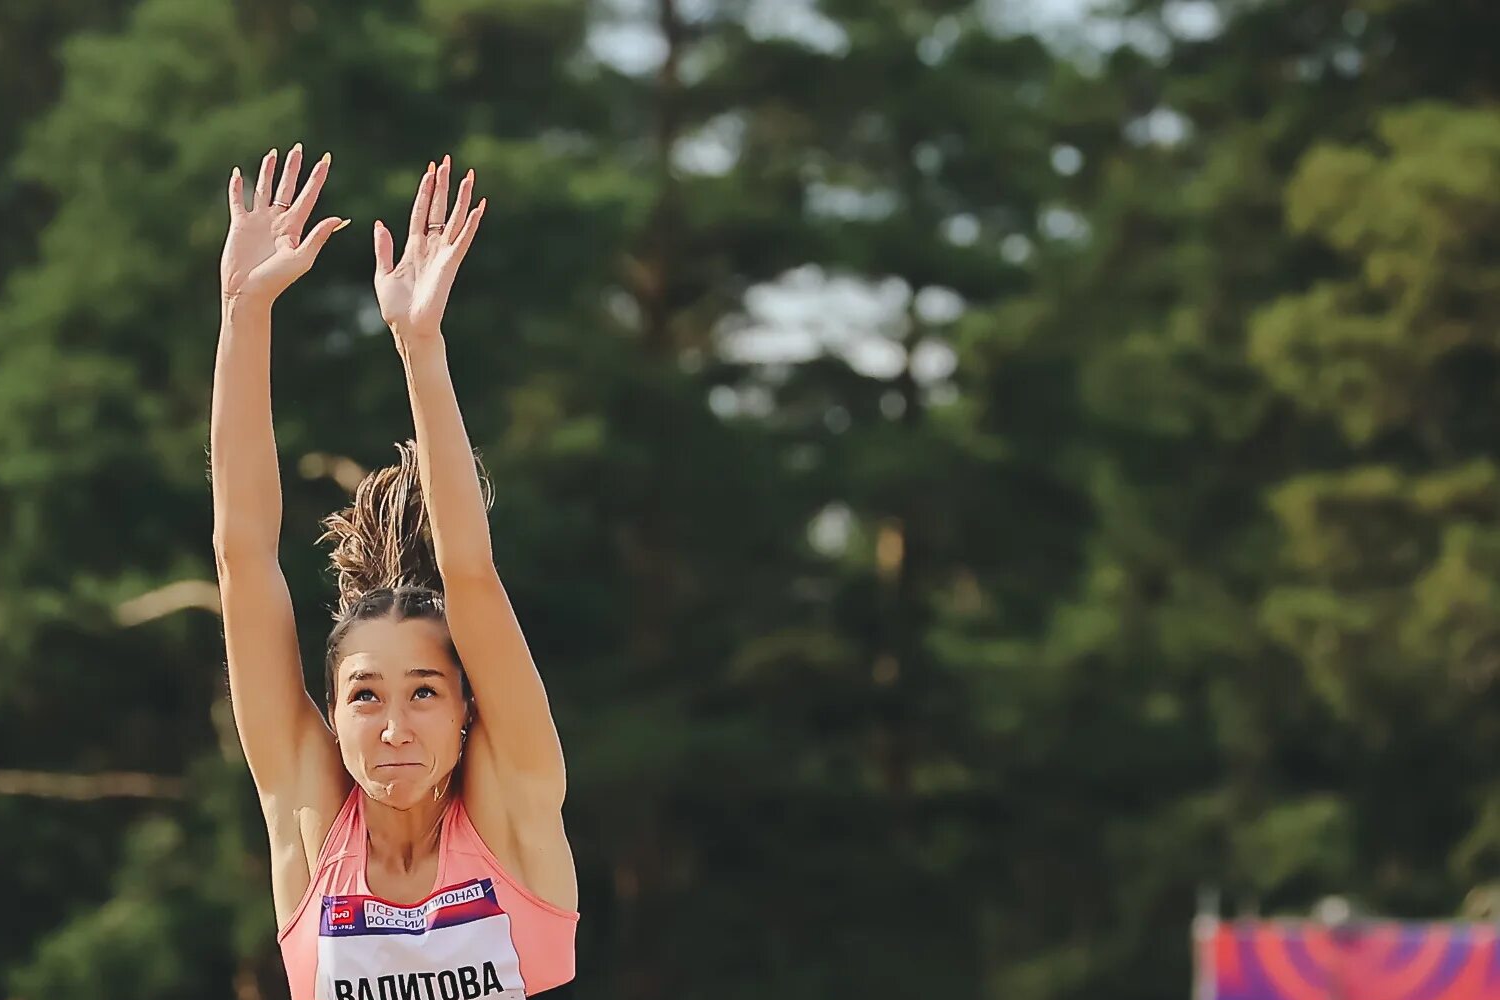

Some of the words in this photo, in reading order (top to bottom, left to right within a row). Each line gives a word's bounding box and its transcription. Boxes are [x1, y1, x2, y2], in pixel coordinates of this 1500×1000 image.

[366, 902, 394, 916] ПСБ
[398, 886, 481, 919] ЧЕМПИОНАТ
[367, 915, 425, 929] РОССИИ
